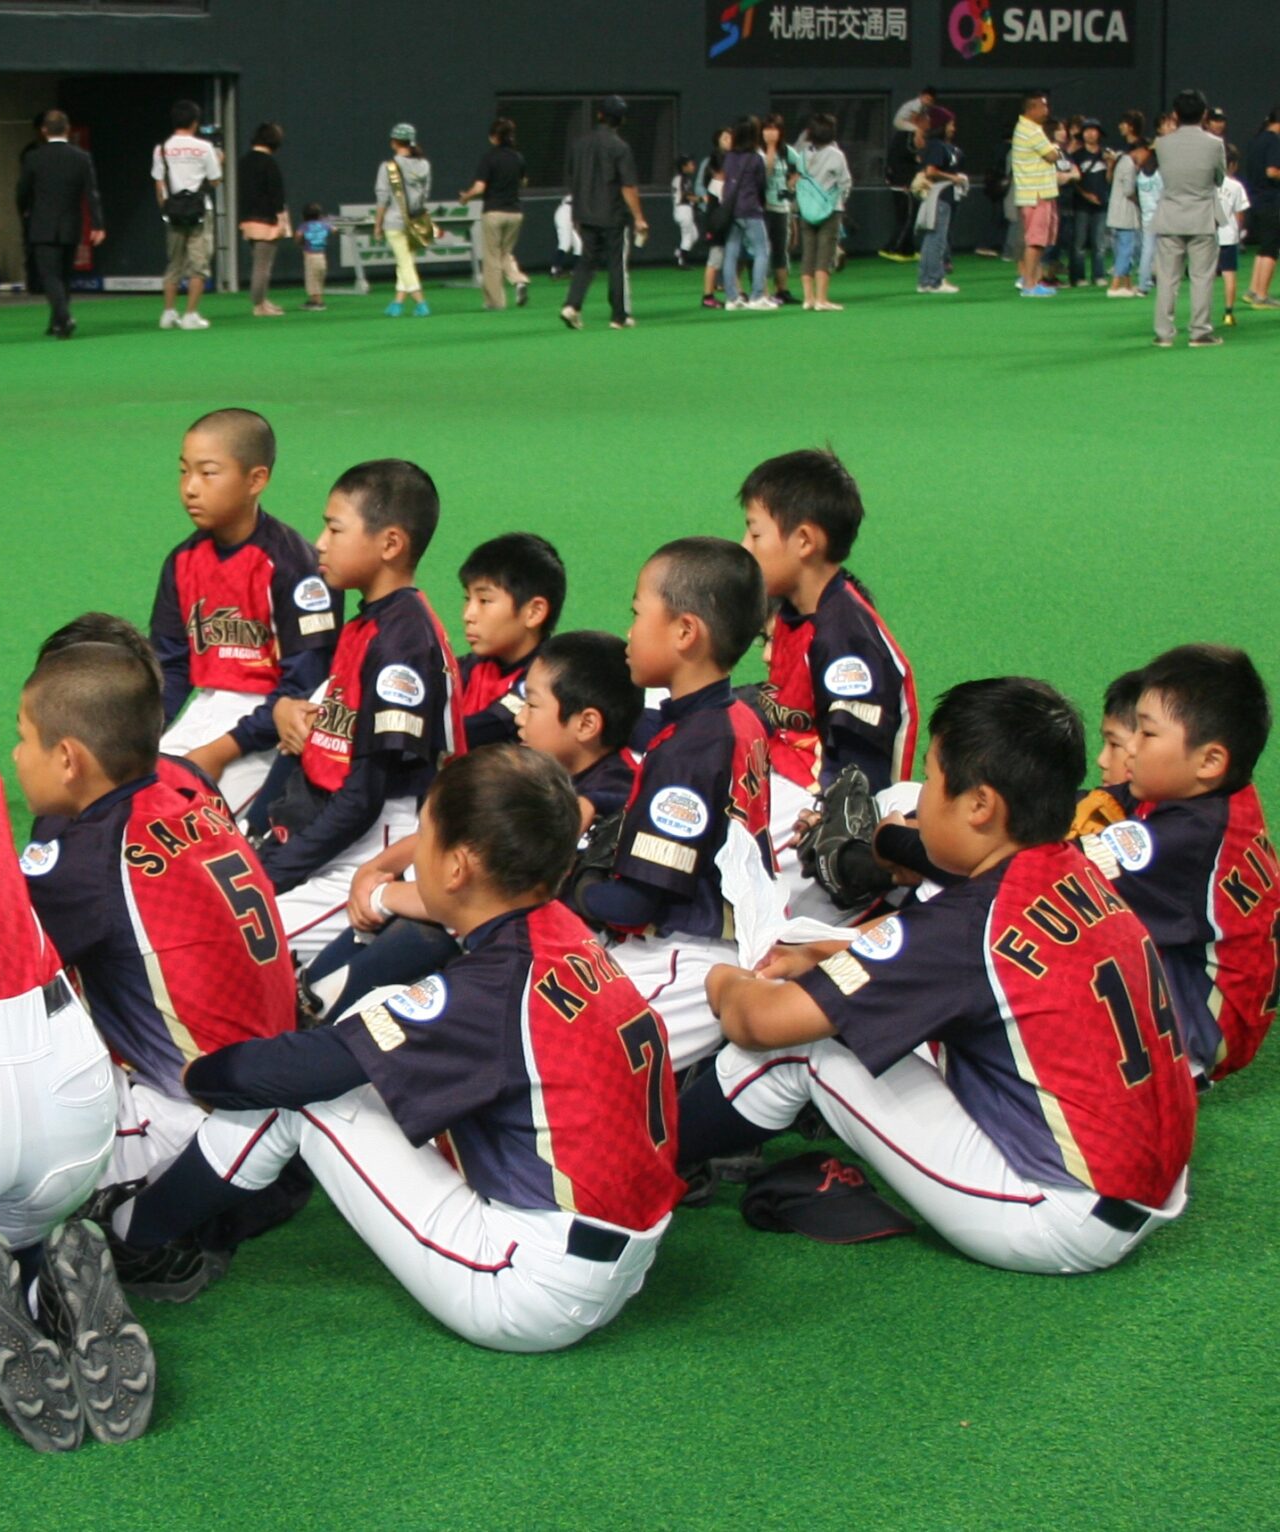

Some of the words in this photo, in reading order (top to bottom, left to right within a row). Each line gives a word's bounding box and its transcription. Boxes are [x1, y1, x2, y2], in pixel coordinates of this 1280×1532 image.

[769, 6, 908, 41] 札幌市交通局
[1002, 7, 1129, 43] SAPICA
[201, 849, 280, 966] 5
[1089, 935, 1184, 1090] 14
[616, 1007, 668, 1152] 7
